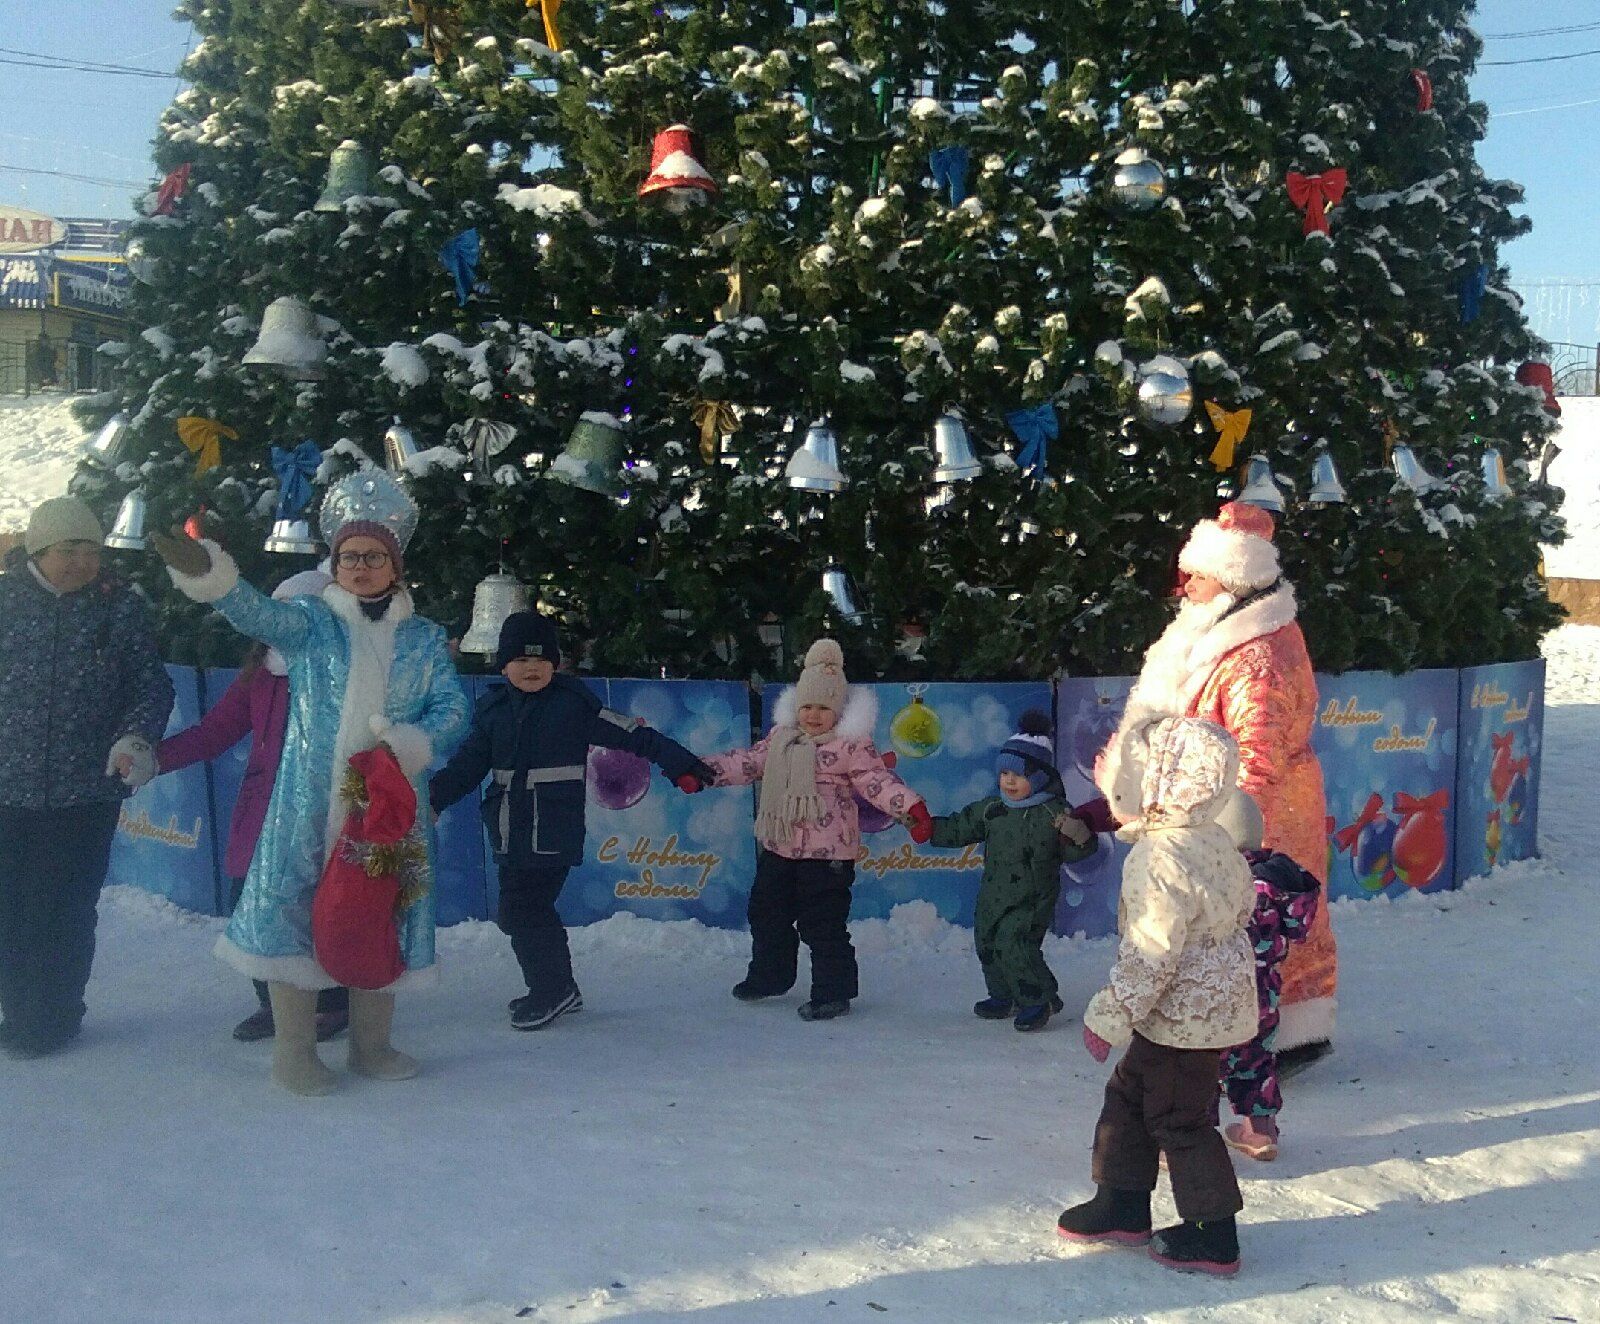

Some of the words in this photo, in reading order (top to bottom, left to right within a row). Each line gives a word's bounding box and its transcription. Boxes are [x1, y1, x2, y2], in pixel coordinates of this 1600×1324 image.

[1320, 695, 1384, 728] Новым
[1373, 717, 1437, 752] годом!
[597, 836, 619, 863] С
[855, 842, 984, 879] Рождество
